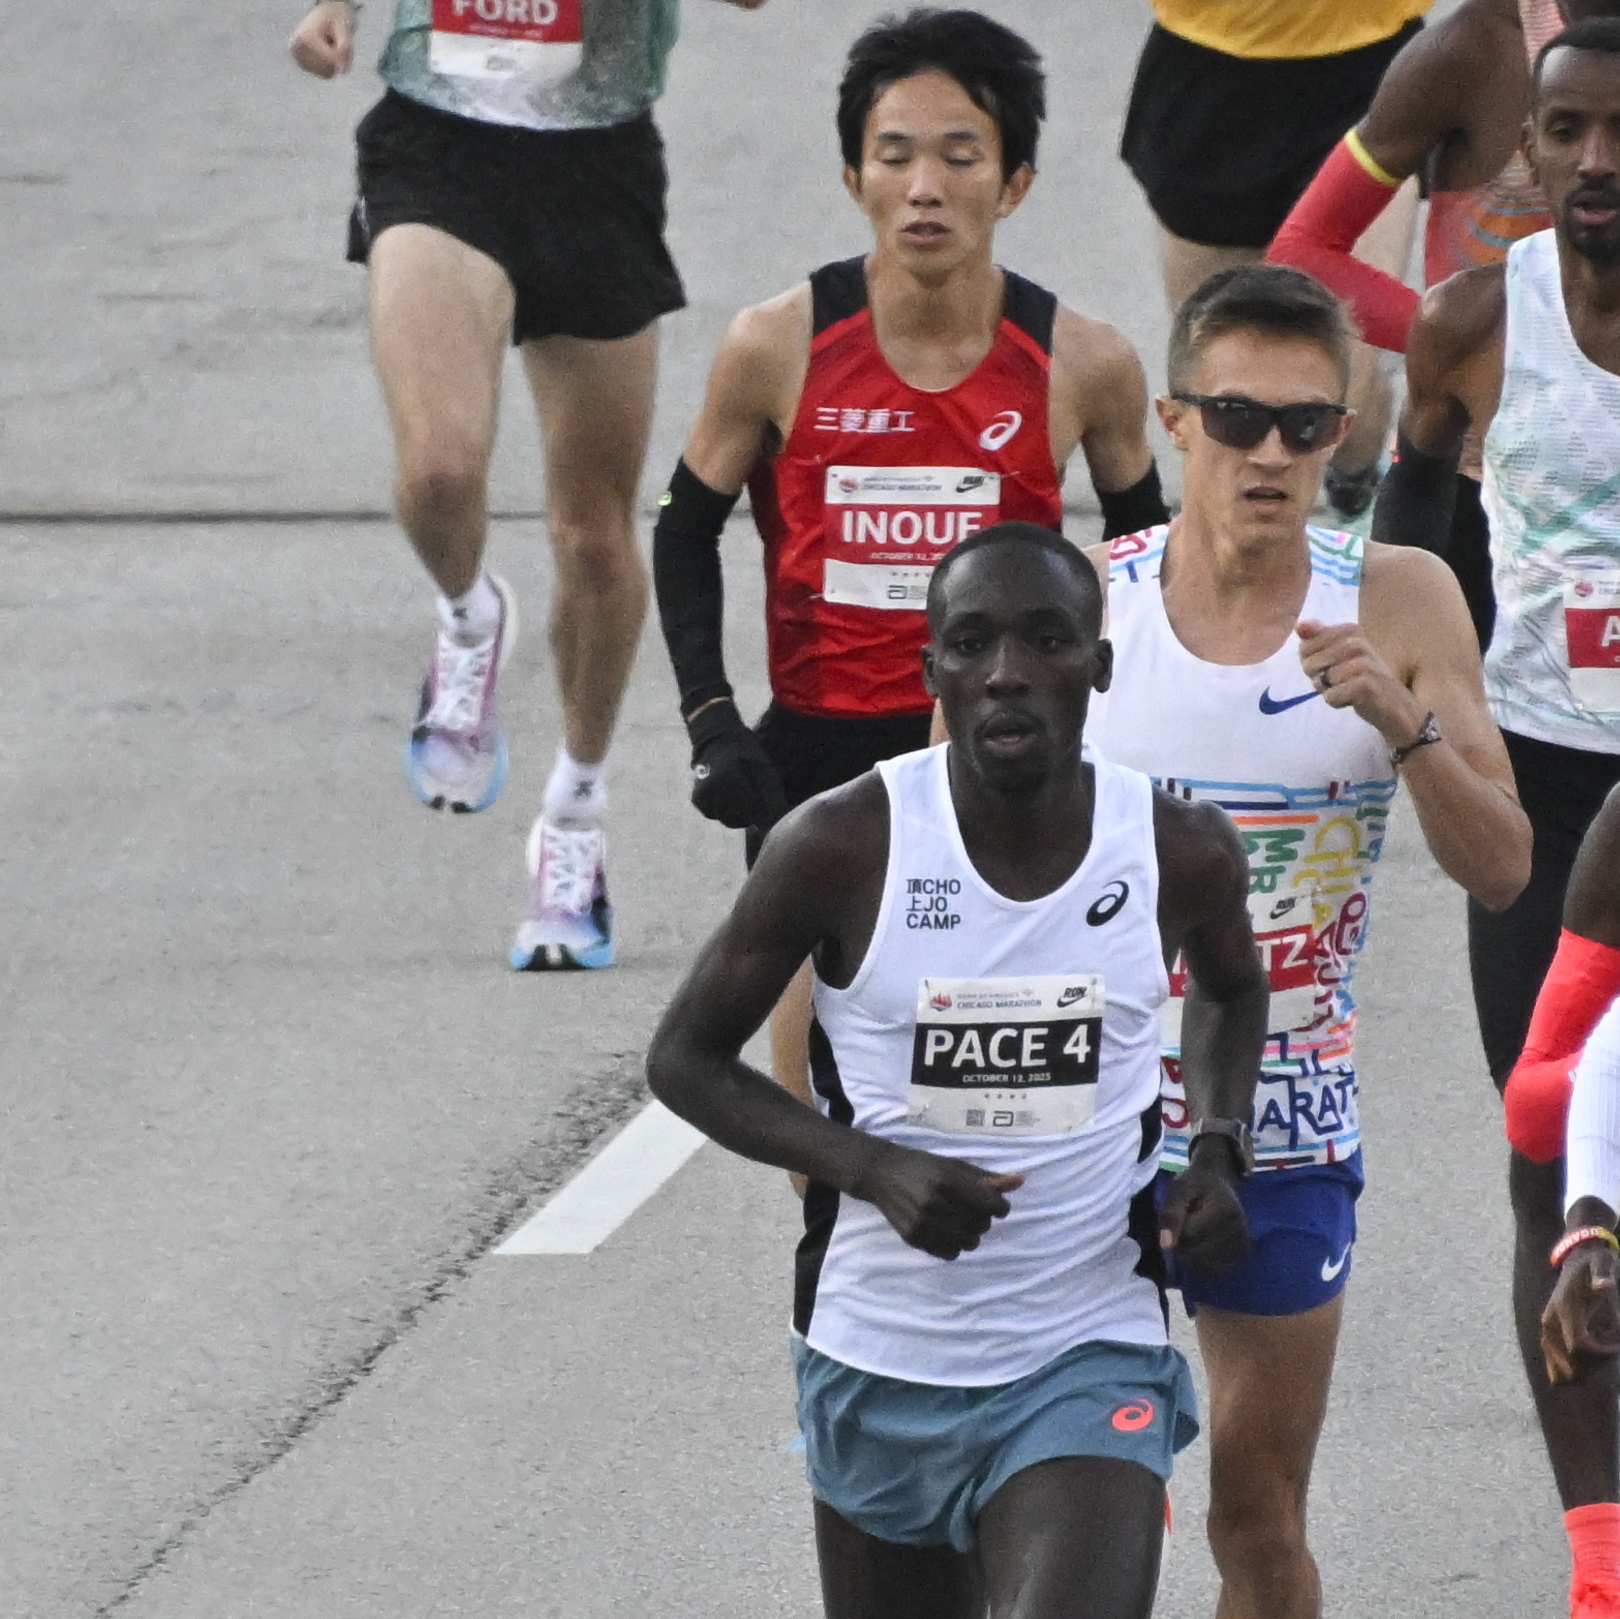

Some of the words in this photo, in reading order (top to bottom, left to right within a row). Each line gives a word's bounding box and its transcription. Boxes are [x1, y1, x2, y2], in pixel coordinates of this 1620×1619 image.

[905, 912, 962, 930] CAMP
[923, 1026, 1049, 1070] PACE
[1062, 1025, 1093, 1065] 4
